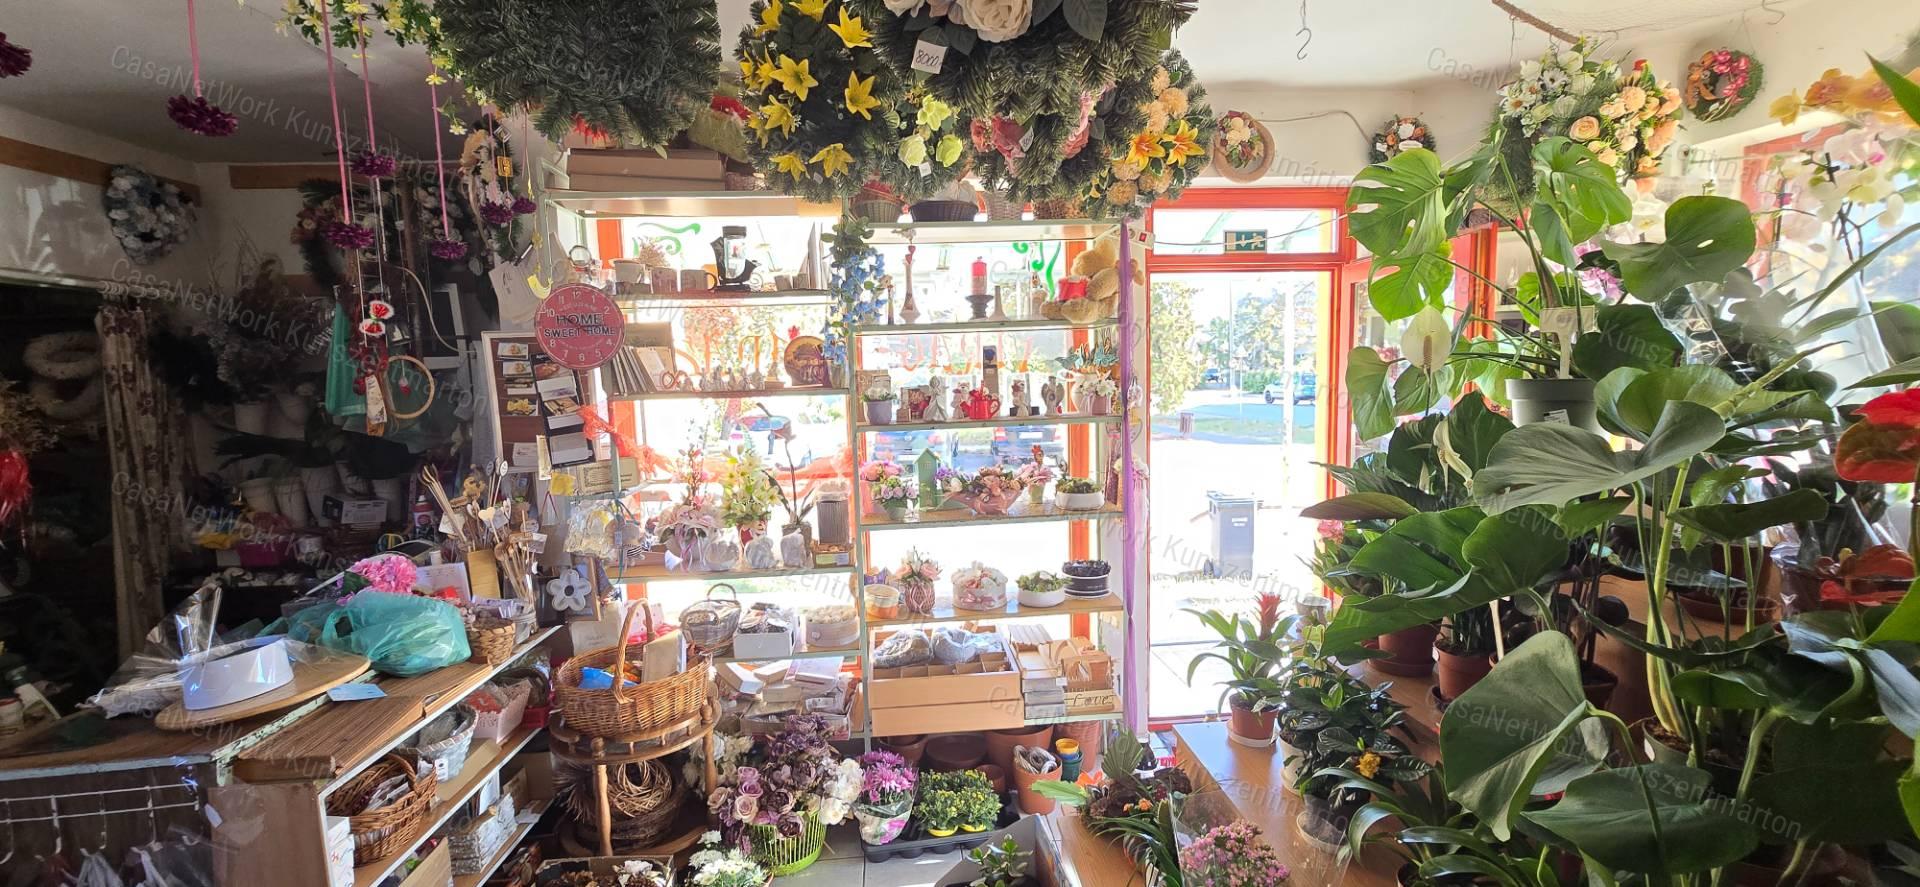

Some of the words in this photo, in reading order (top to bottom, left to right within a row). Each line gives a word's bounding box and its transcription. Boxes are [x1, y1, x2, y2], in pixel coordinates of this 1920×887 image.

[572, 290, 582, 300] 12
[603, 305, 611, 315] 2
[556, 313, 604, 326] HOME
[544, 327, 581, 338] SWEET
[586, 326, 616, 336] HOME
